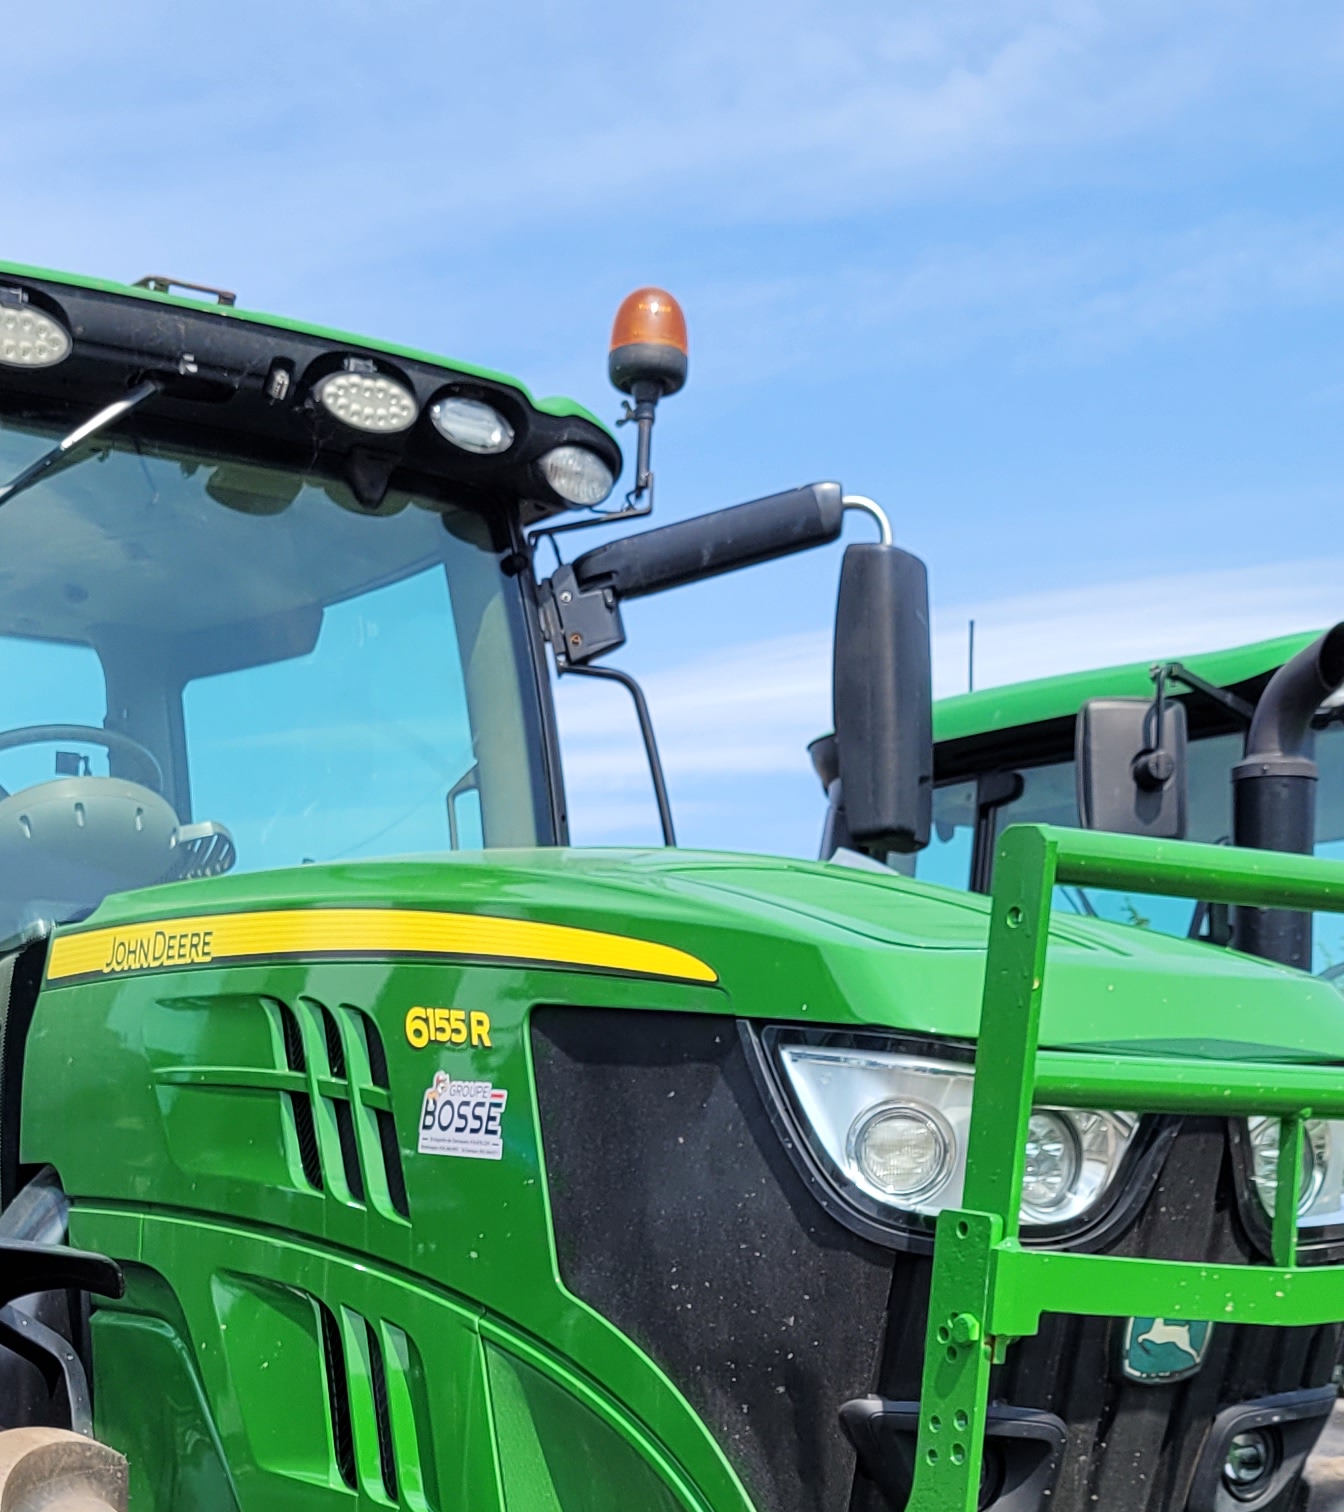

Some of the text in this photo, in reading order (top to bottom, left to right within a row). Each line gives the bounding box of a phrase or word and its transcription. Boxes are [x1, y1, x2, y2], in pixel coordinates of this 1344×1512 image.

[104, 930, 214, 969] JOHN DEERE
[449, 1083, 490, 1099] GROUPE
[421, 1099, 504, 1136] BOSSE
